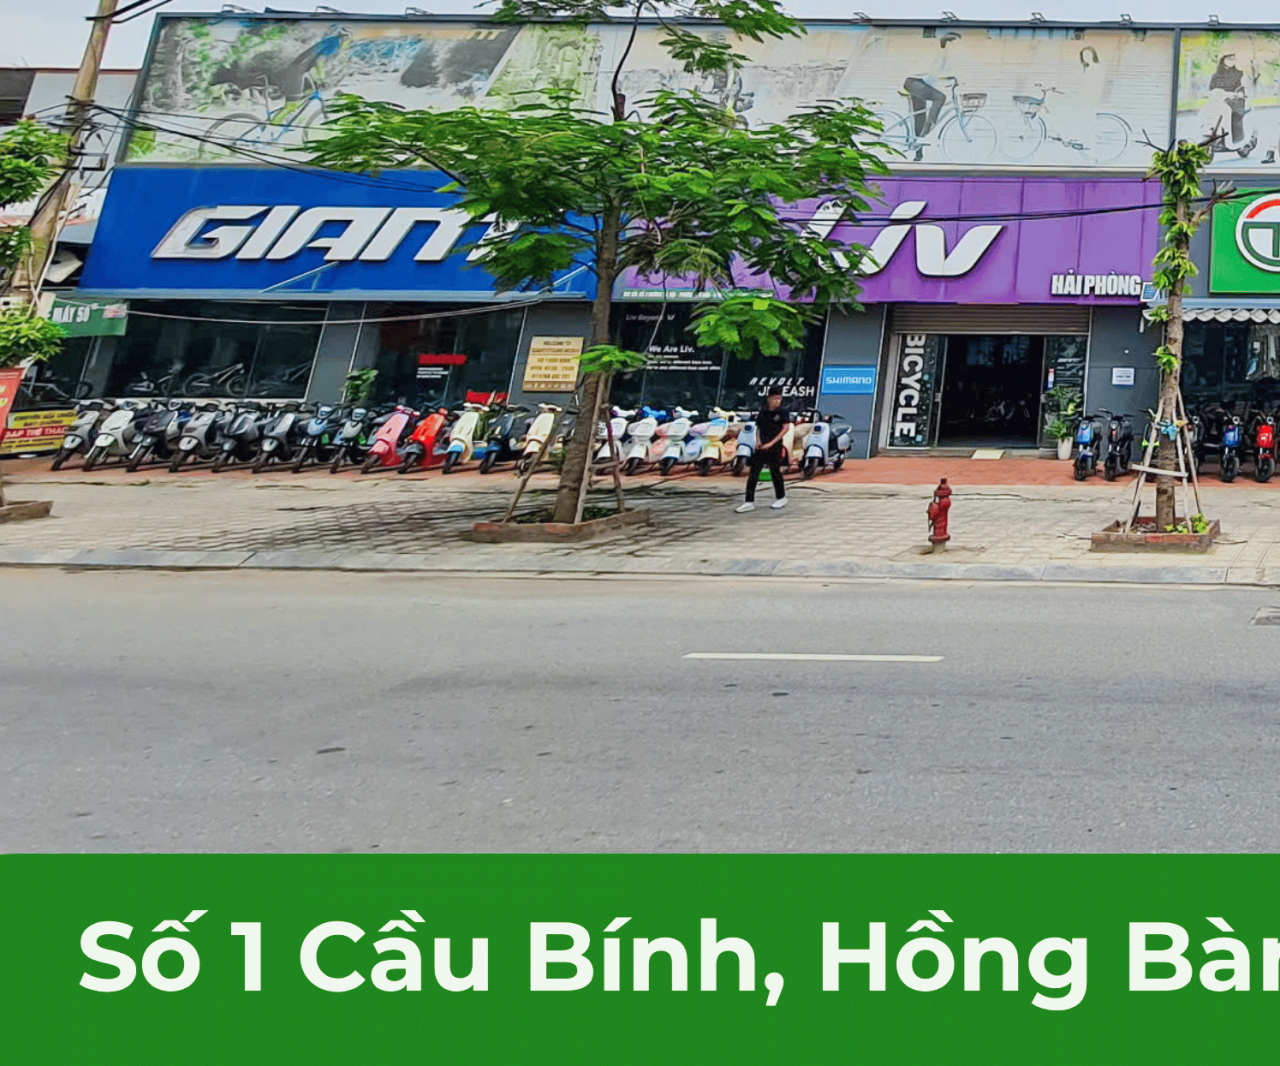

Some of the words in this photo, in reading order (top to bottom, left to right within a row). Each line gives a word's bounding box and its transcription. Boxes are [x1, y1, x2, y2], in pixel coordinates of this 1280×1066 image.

[1051, 269, 1083, 295] HẢI
[1083, 270, 1141, 295] PHÒNG
[649, 345, 662, 353] We
[663, 345, 678, 353] Are
[749, 377, 804, 385] REVOLT
[825, 376, 872, 385] SHIMANO
[894, 334, 926, 438] BICYCLE
